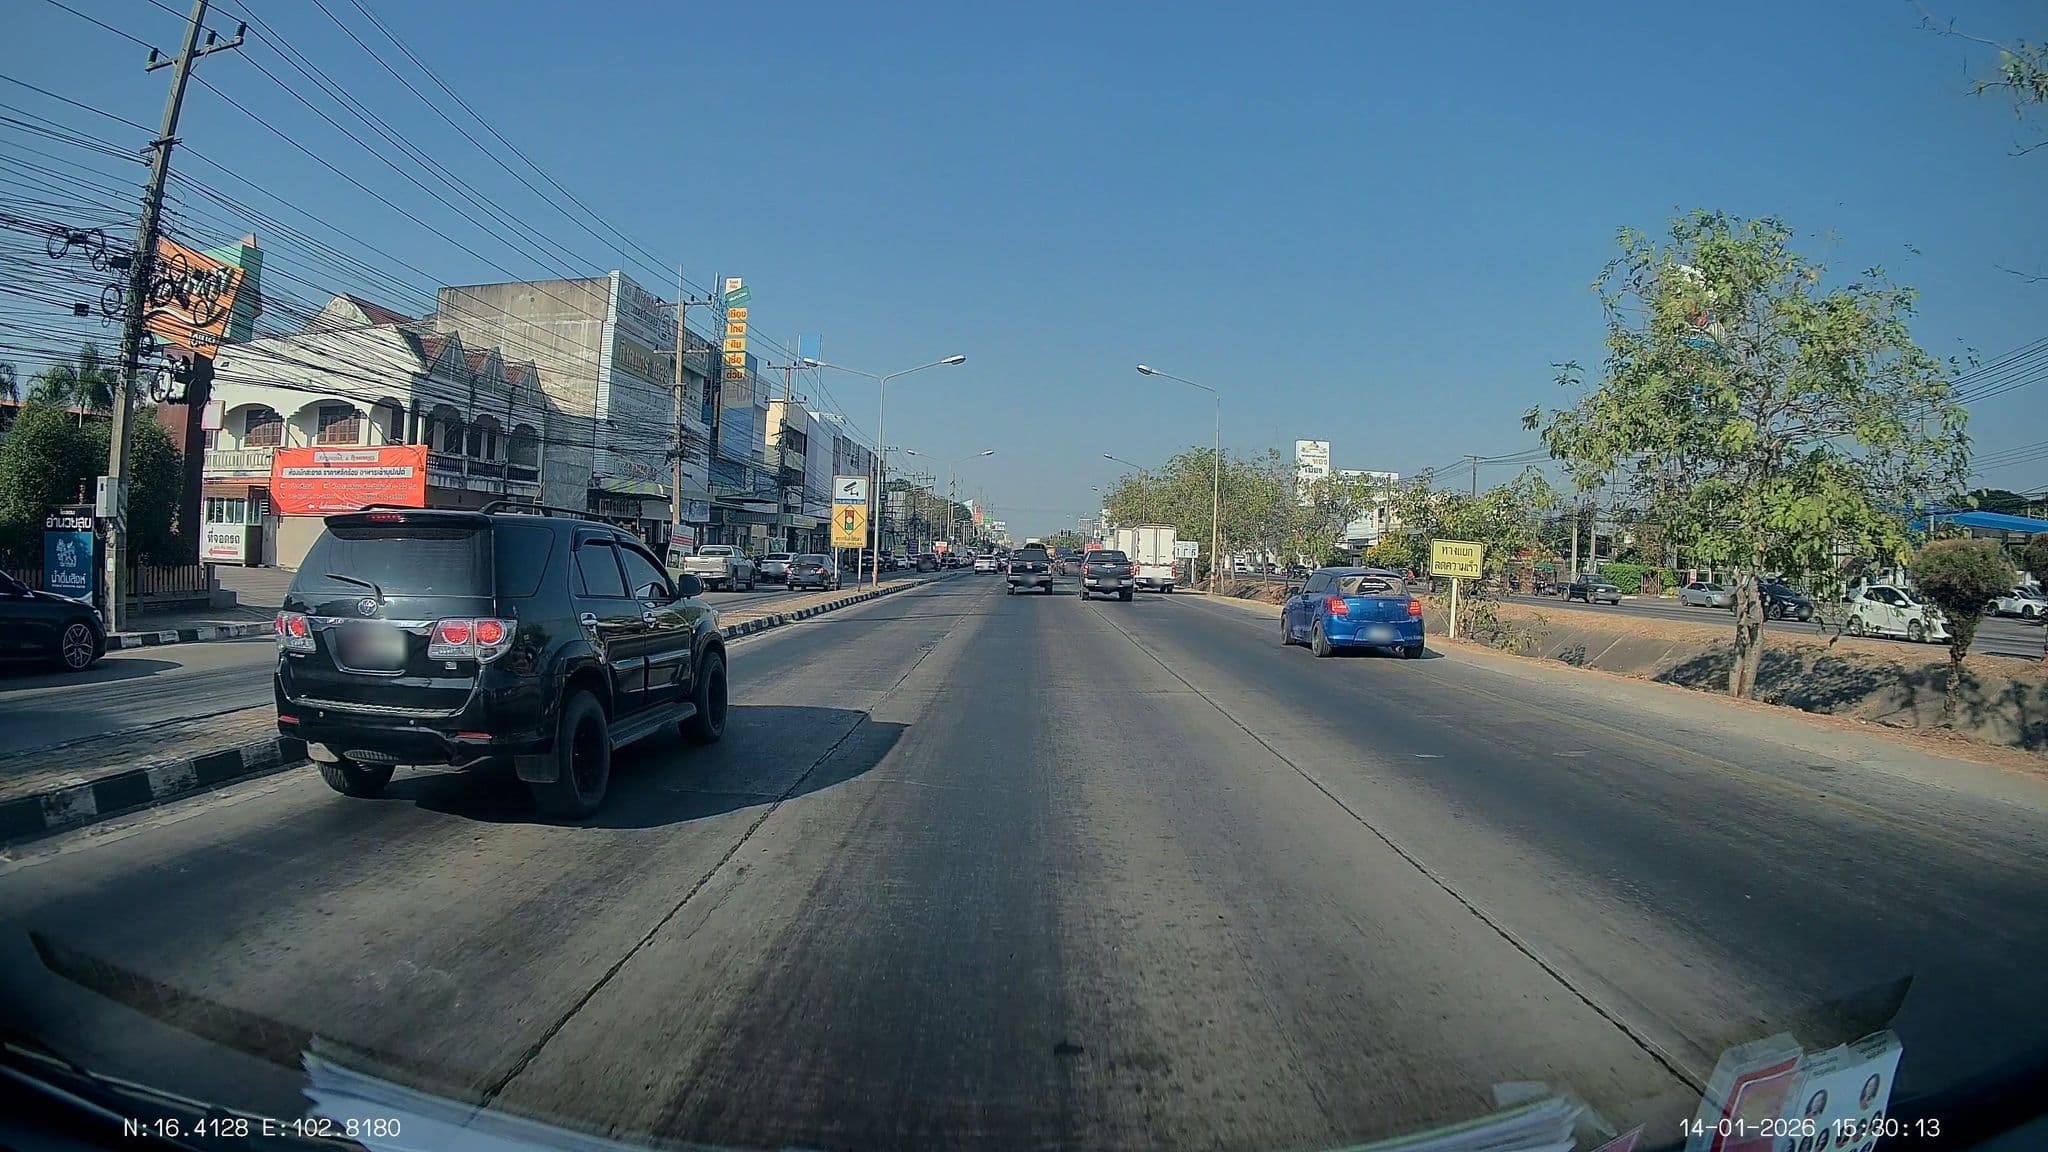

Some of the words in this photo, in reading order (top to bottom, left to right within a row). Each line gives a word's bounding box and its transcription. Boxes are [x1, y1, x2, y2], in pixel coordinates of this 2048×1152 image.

[46, 513, 92, 532] อำนวยสุข
[207, 527, 240, 544] ที่จอดรถ
[1441, 546, 1473, 557] ทางแยก
[1434, 560, 1478, 572] ลดความเร็ว
[51, 570, 87, 584] น้ำดื่มสิงห์
